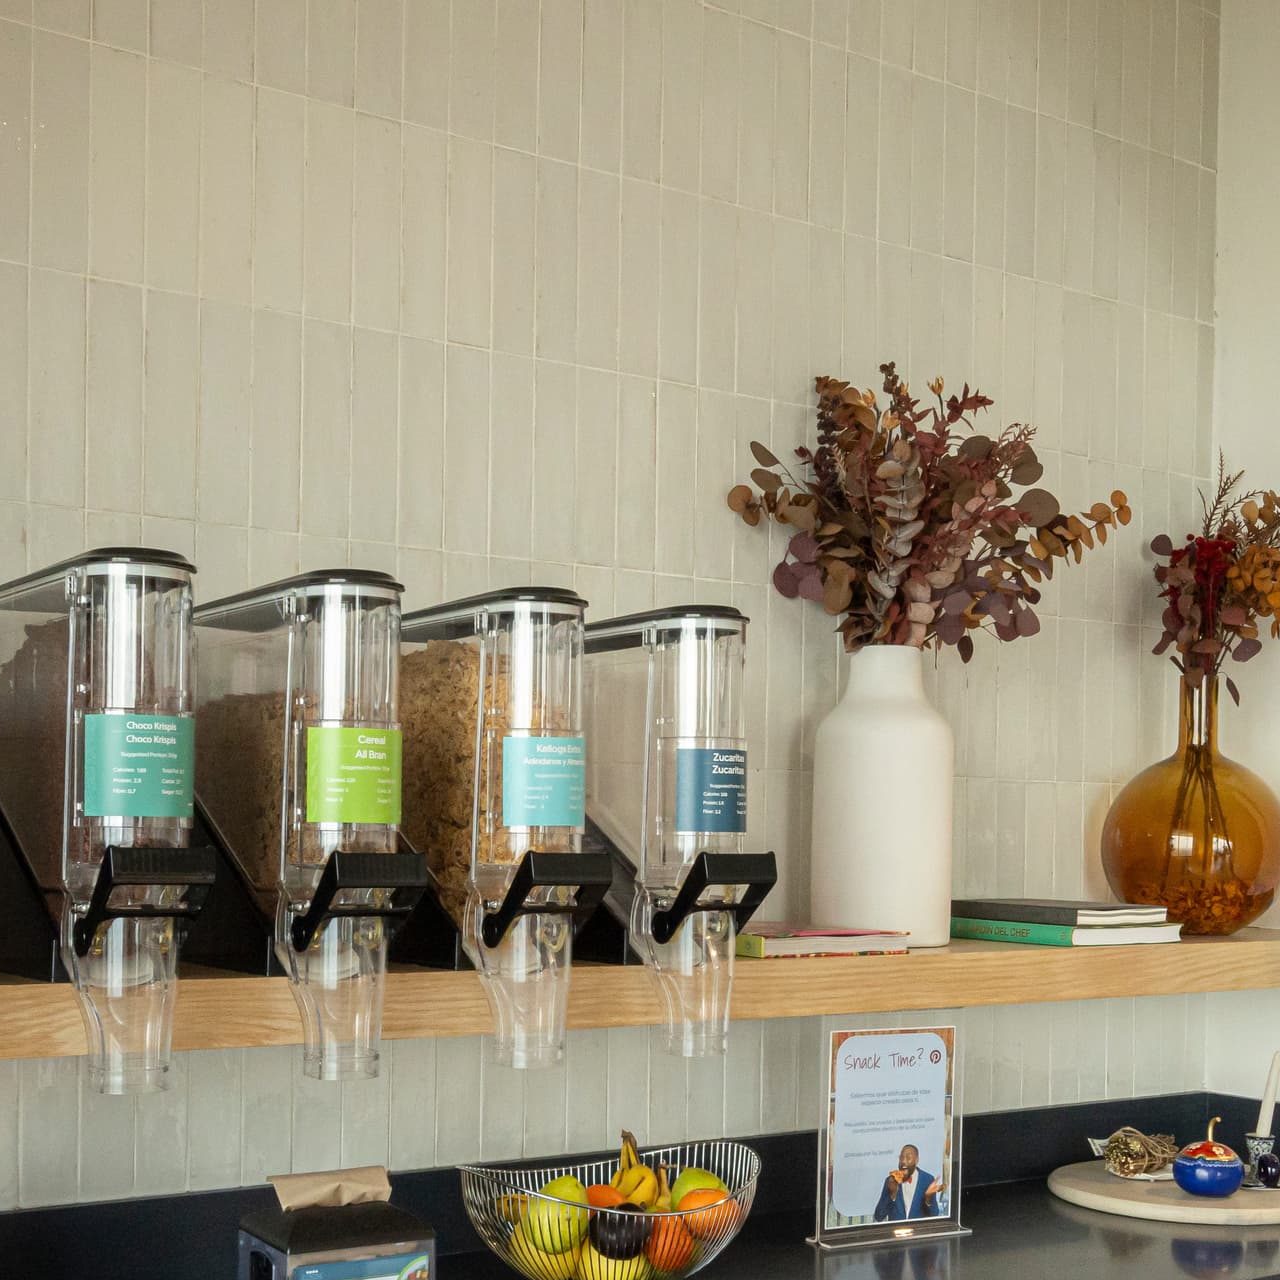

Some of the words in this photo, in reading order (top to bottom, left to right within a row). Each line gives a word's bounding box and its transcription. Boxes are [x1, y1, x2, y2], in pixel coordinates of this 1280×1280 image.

[127, 721, 152, 731] Choco
[154, 722, 177, 732] Krispis
[126, 735, 152, 743] Choco
[153, 736, 176, 745] Krispis
[358, 735, 386, 745] Cereal
[355, 750, 367, 759] All
[369, 750, 386, 760] Bran
[844, 1054, 881, 1070] Snack
